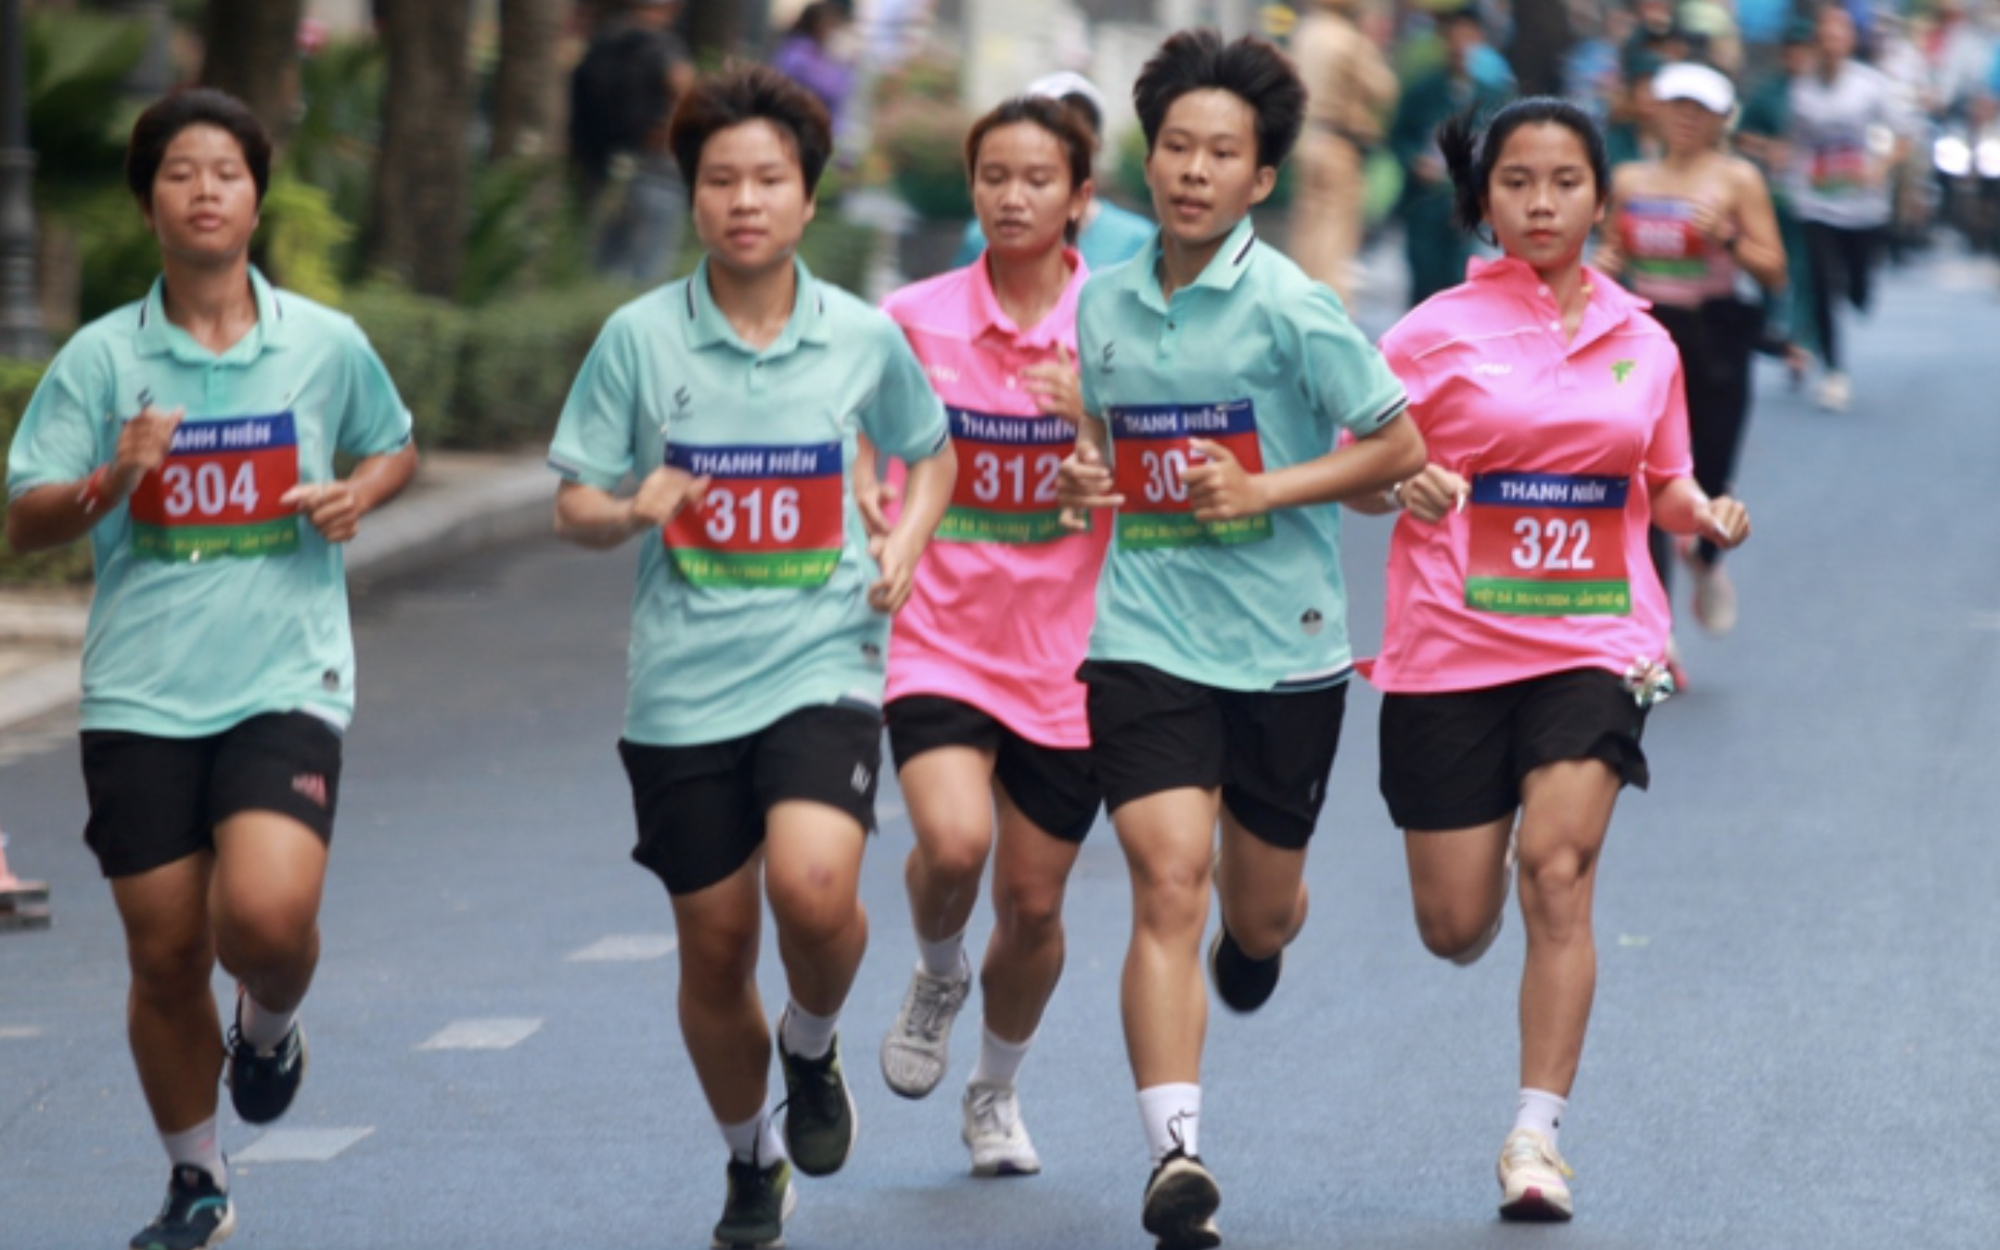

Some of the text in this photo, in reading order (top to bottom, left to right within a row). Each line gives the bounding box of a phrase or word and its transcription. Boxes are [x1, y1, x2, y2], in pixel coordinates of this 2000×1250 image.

[961, 412, 1027, 440] THANH
[1123, 408, 1228, 432] THANH NIÊN
[170, 421, 271, 450] ANH NIÊN
[691, 449, 817, 473] THANH NIÊN
[162, 460, 259, 516] 304
[973, 451, 1061, 503] 312
[1500, 481, 1607, 502] THANH NIÊN
[705, 486, 800, 543] 316
[1511, 516, 1594, 570] 322
